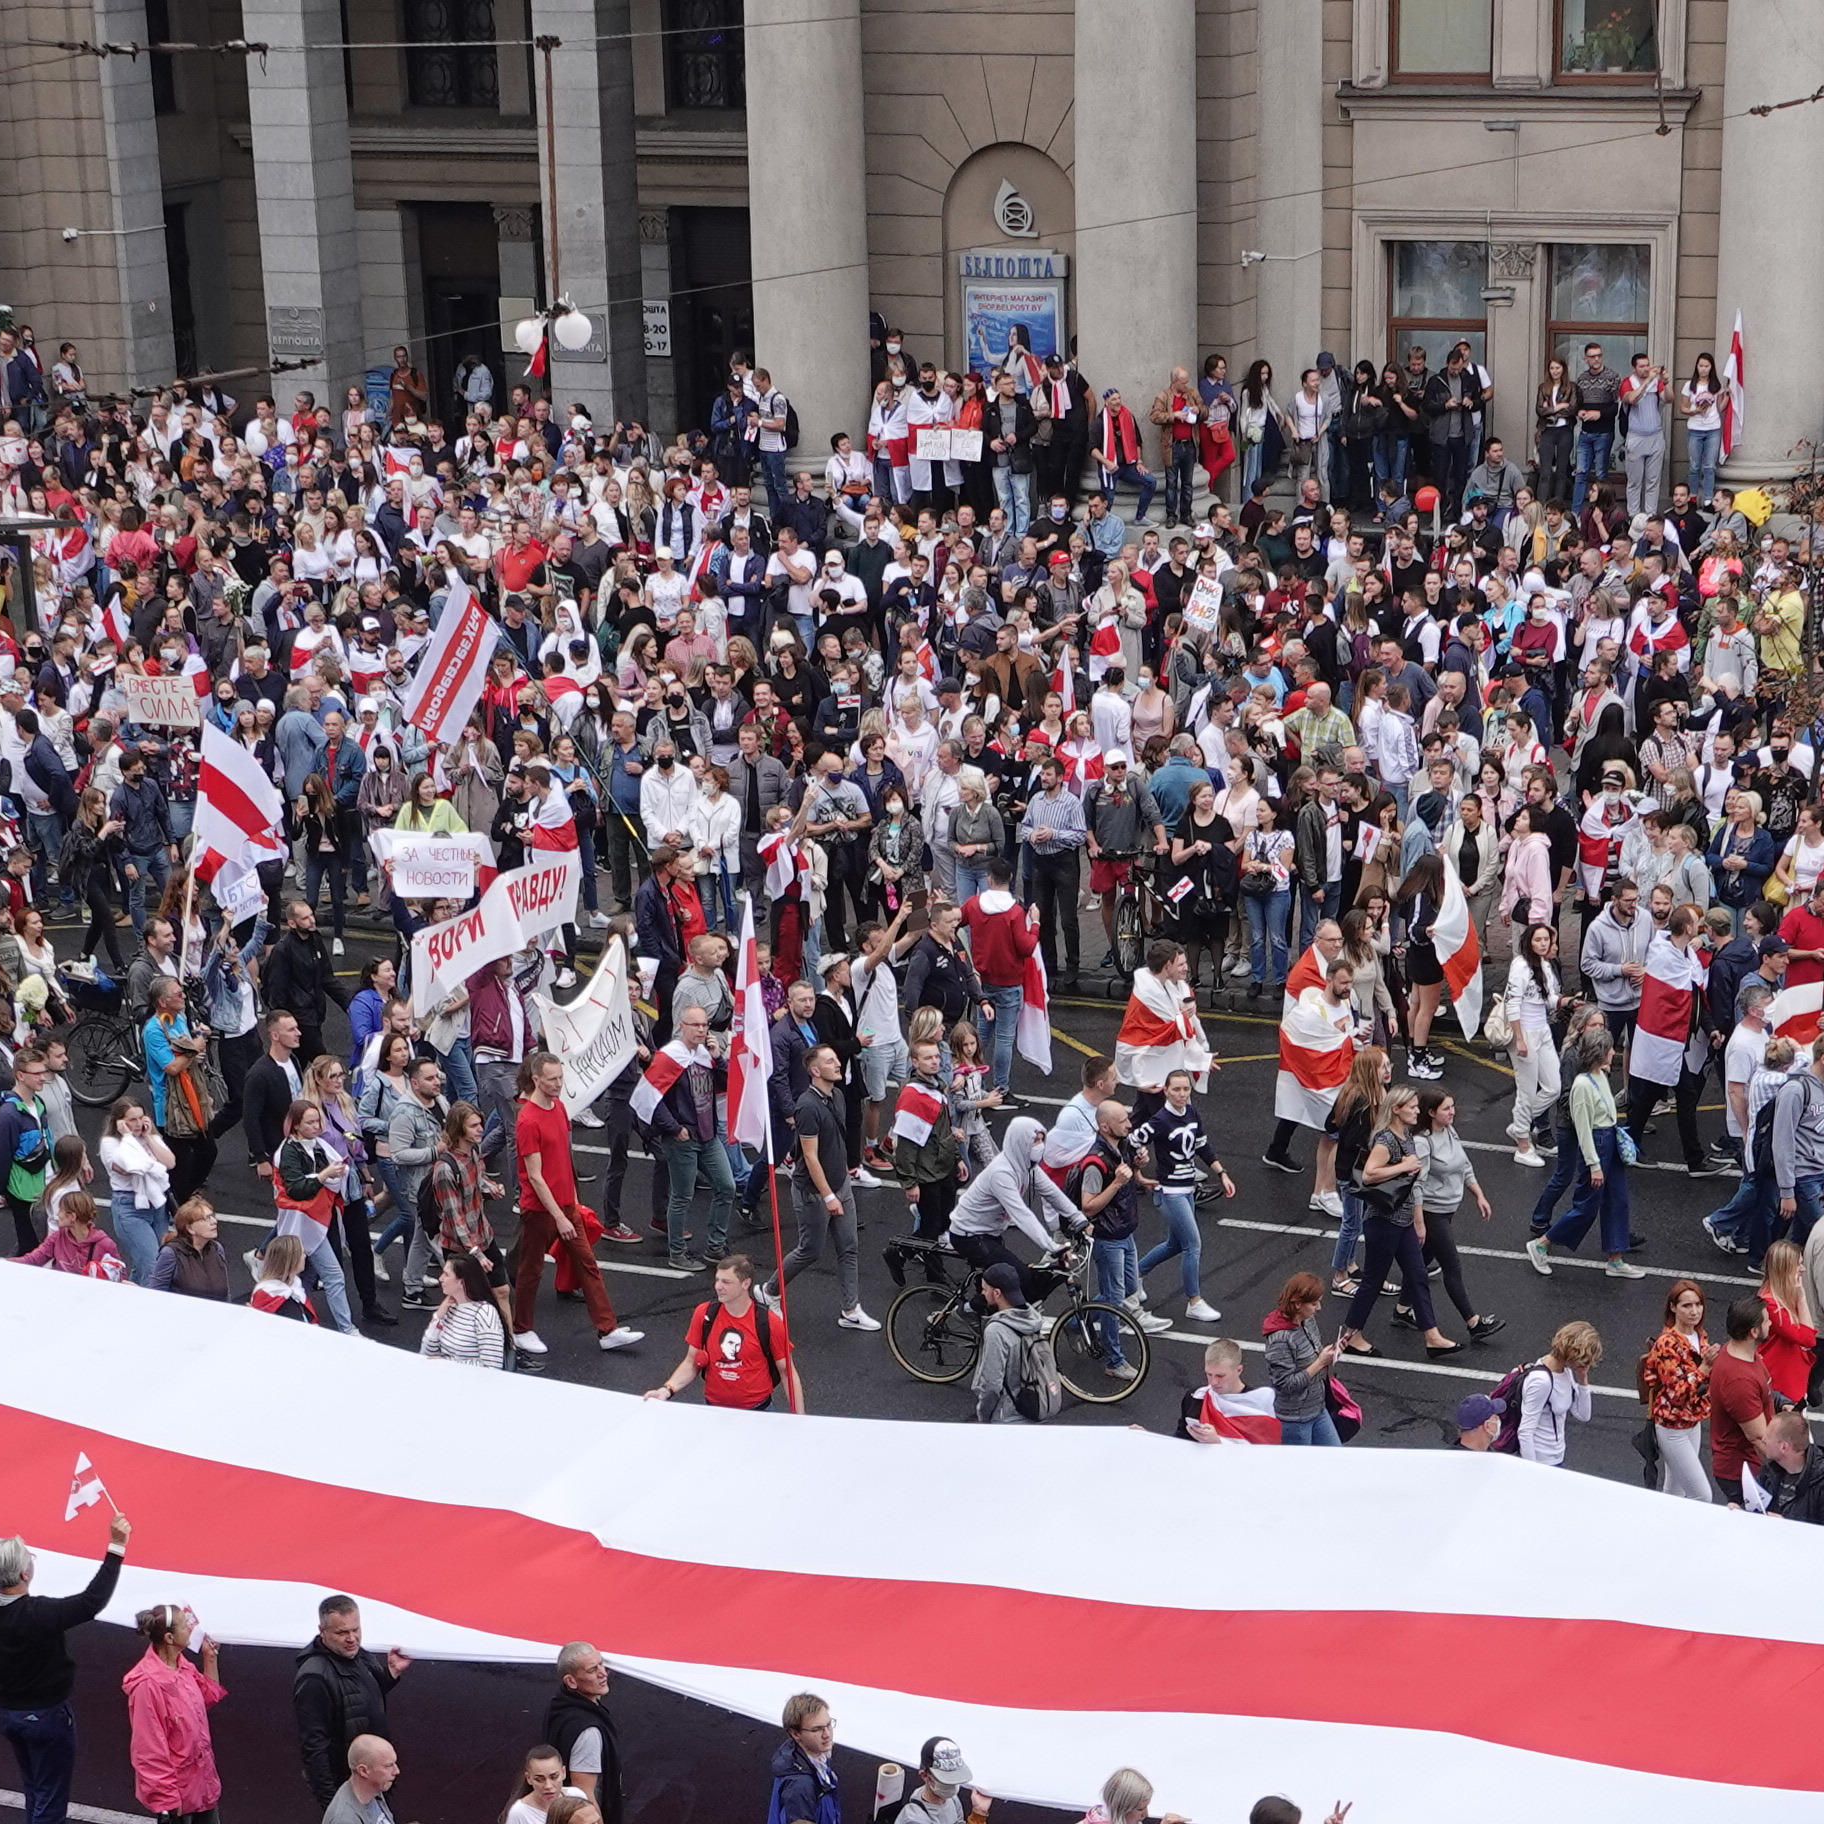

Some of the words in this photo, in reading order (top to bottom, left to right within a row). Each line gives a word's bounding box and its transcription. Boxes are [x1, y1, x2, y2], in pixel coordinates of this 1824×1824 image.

[965, 256, 1055, 278] БЕЛПОШТА
[973, 294, 1047, 303] ИНТЕРНЕТ-МАГАЗИН
[643, 305, 667, 314] ОШТА
[978, 303, 1042, 312] SHOP.BELPOST.BY
[272, 335, 322, 347] БЕЛПОШТА
[645, 341, 667, 350] 0-17
[140, 696, 194, 721] СИЛА
[402, 846, 419, 863] ЗА
[428, 847, 476, 862] ЧЕСТНЫЕ
[406, 869, 468, 887] НОВОСТИ
